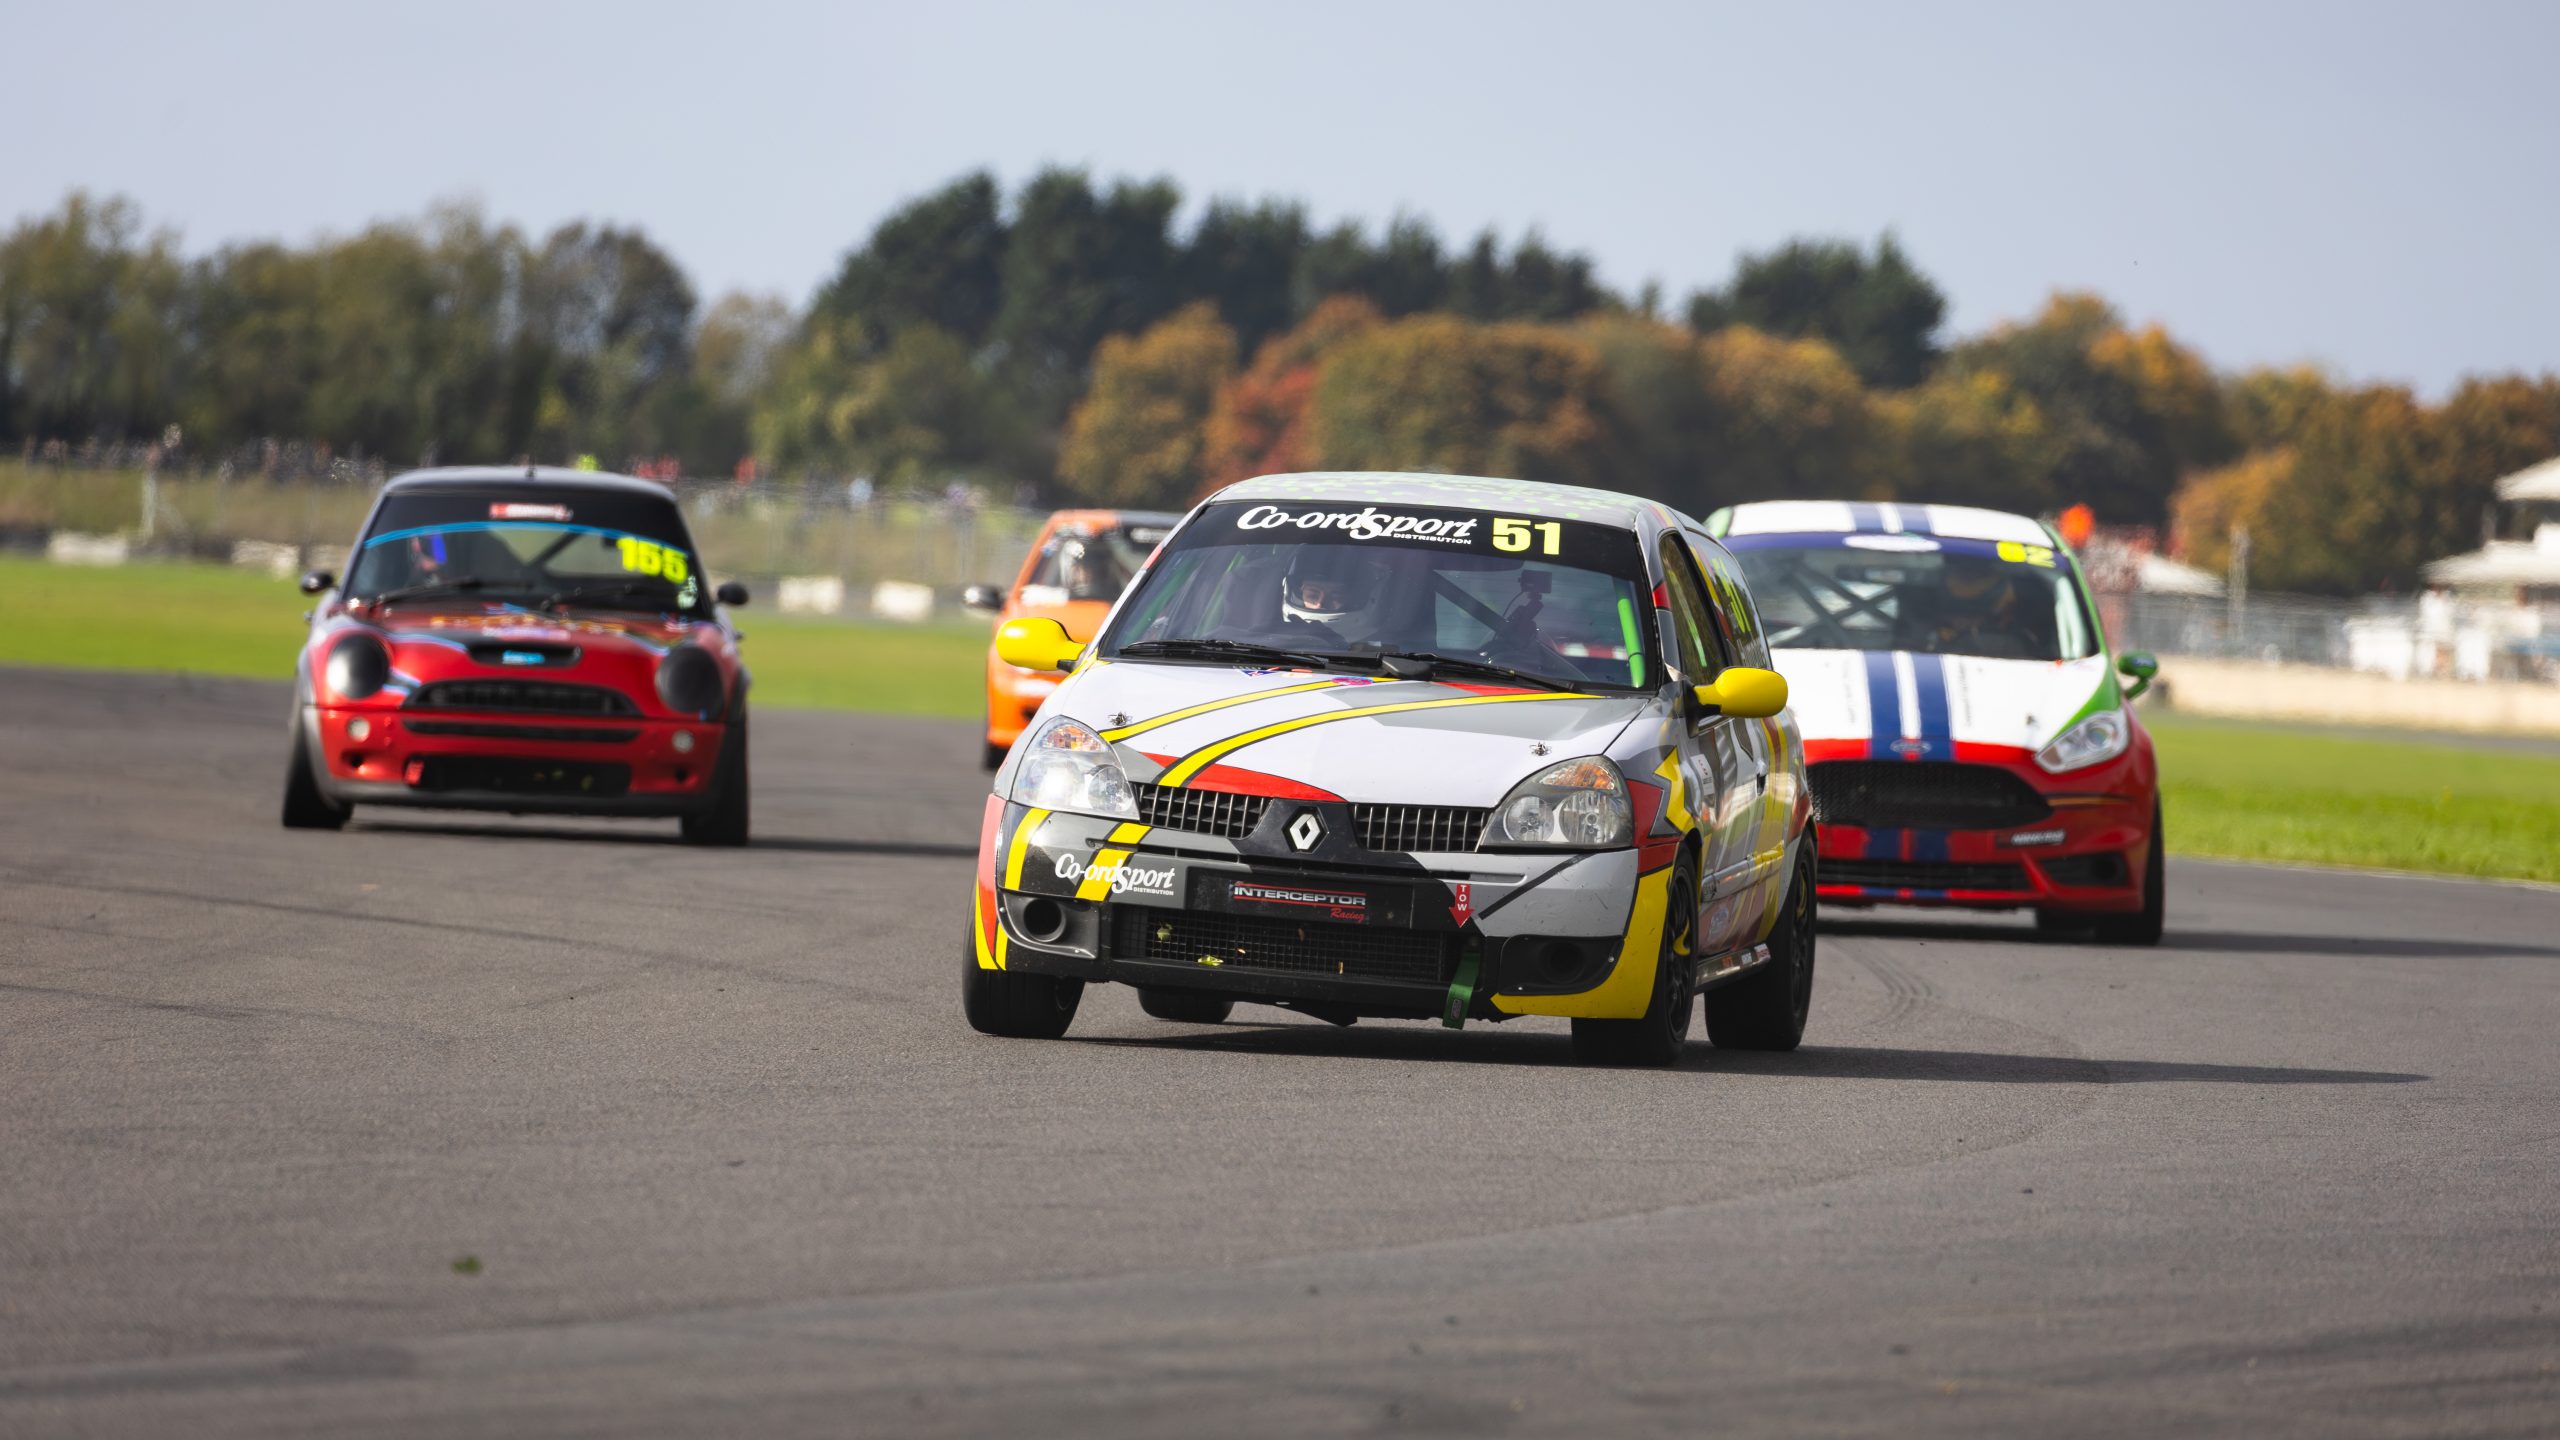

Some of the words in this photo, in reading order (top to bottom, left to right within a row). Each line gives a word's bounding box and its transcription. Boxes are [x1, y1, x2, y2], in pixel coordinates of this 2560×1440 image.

[1392, 533, 1473, 545] DISTRIBUTION
[1492, 517, 1561, 555] 51
[616, 537, 688, 585] 155
[1133, 887, 1174, 896] DISTRIBUTION
[1234, 886, 1367, 906] INTERCEPTOR
[1457, 884, 1468, 911] TOW
[1330, 907, 1366, 924] Racing
